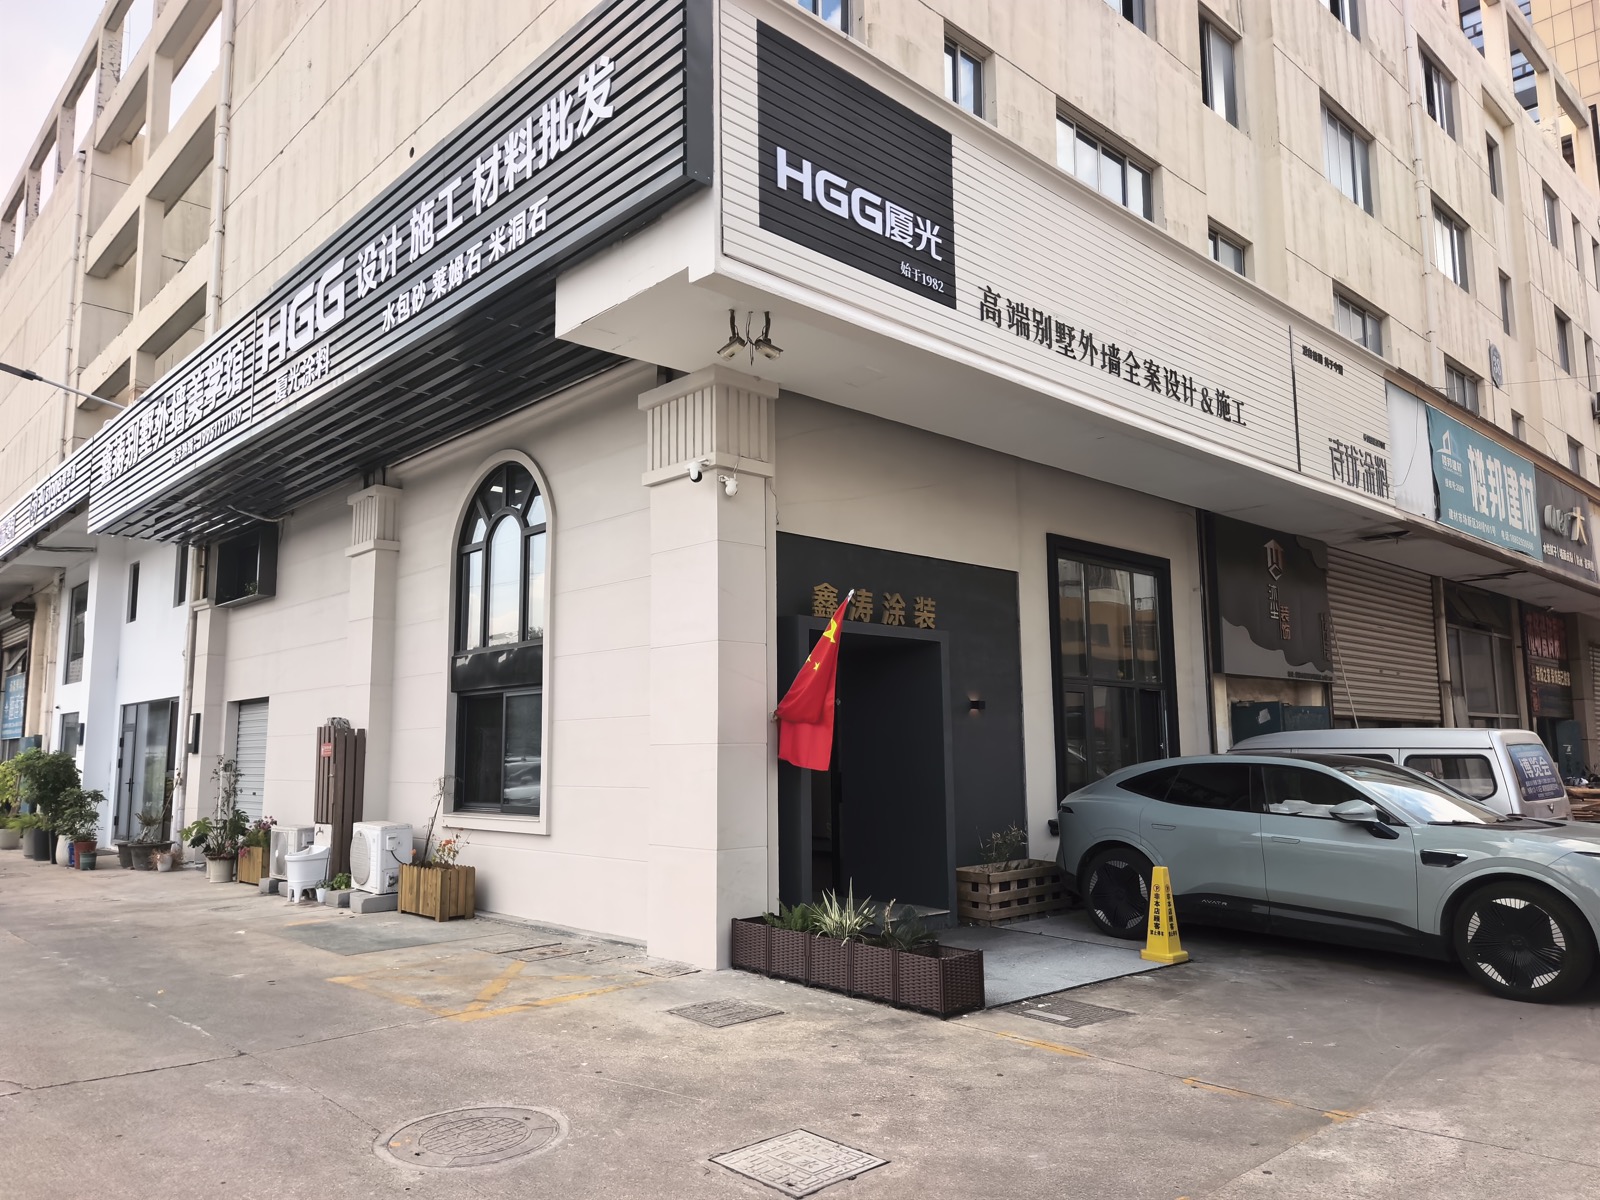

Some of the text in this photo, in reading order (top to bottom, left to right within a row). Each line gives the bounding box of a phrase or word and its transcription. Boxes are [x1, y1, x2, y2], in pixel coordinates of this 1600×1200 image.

[355, 55, 615, 298] 设计 施工 材料批发
[260, 257, 346, 375] HGG
[381, 195, 549, 333] 水包砂 莱姆石 米洞石
[900, 261, 944, 293] 始于1982
[977, 285, 1247, 427] 高端别墅外墙全案设计&施工
[812, 582, 936, 630] 鑫涛涂装
[1519, 756, 1552, 779] 博览会
